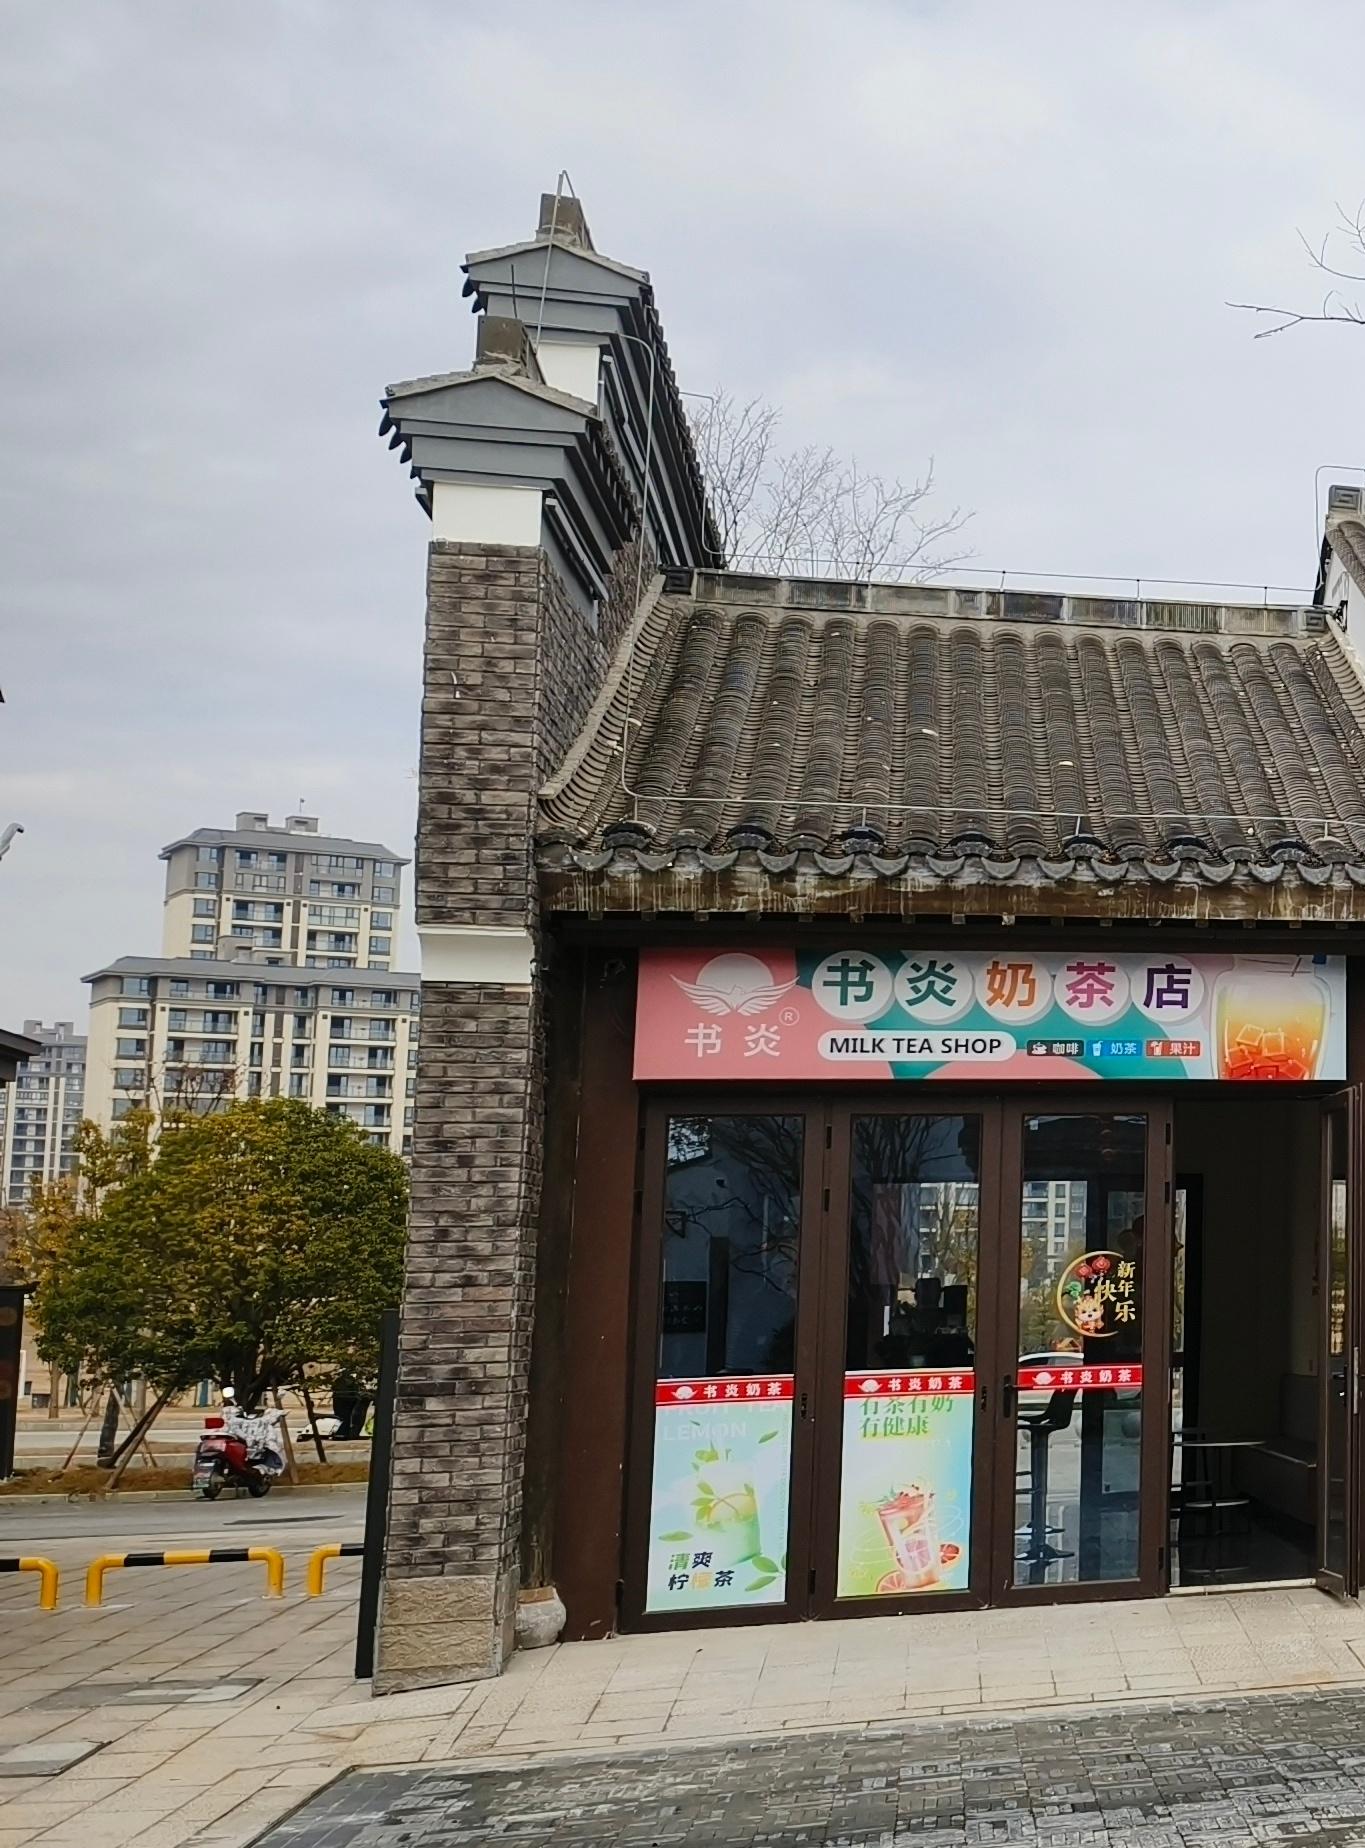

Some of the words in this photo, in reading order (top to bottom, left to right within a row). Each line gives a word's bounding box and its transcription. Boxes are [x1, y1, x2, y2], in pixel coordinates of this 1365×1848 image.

[822, 958, 1192, 1010] 书炎奶茶店
[684, 1022, 781, 1057] 书炎
[829, 1037, 885, 1054] MILK
[894, 1037, 935, 1054] TEA
[940, 1037, 1002, 1055] SHOP
[1052, 1042, 1080, 1055] 咖啡
[1110, 1042, 1137, 1055] 奶茶
[1169, 1042, 1196, 1055] 果汁
[888, 1375, 963, 1392] 书炎奶茶
[1061, 1368, 1132, 1384] 书炎奶茶
[703, 1381, 782, 1398] 书炎奶茶
[664, 1421, 747, 1441] LEMON
[668, 1551, 714, 1571] 清爽
